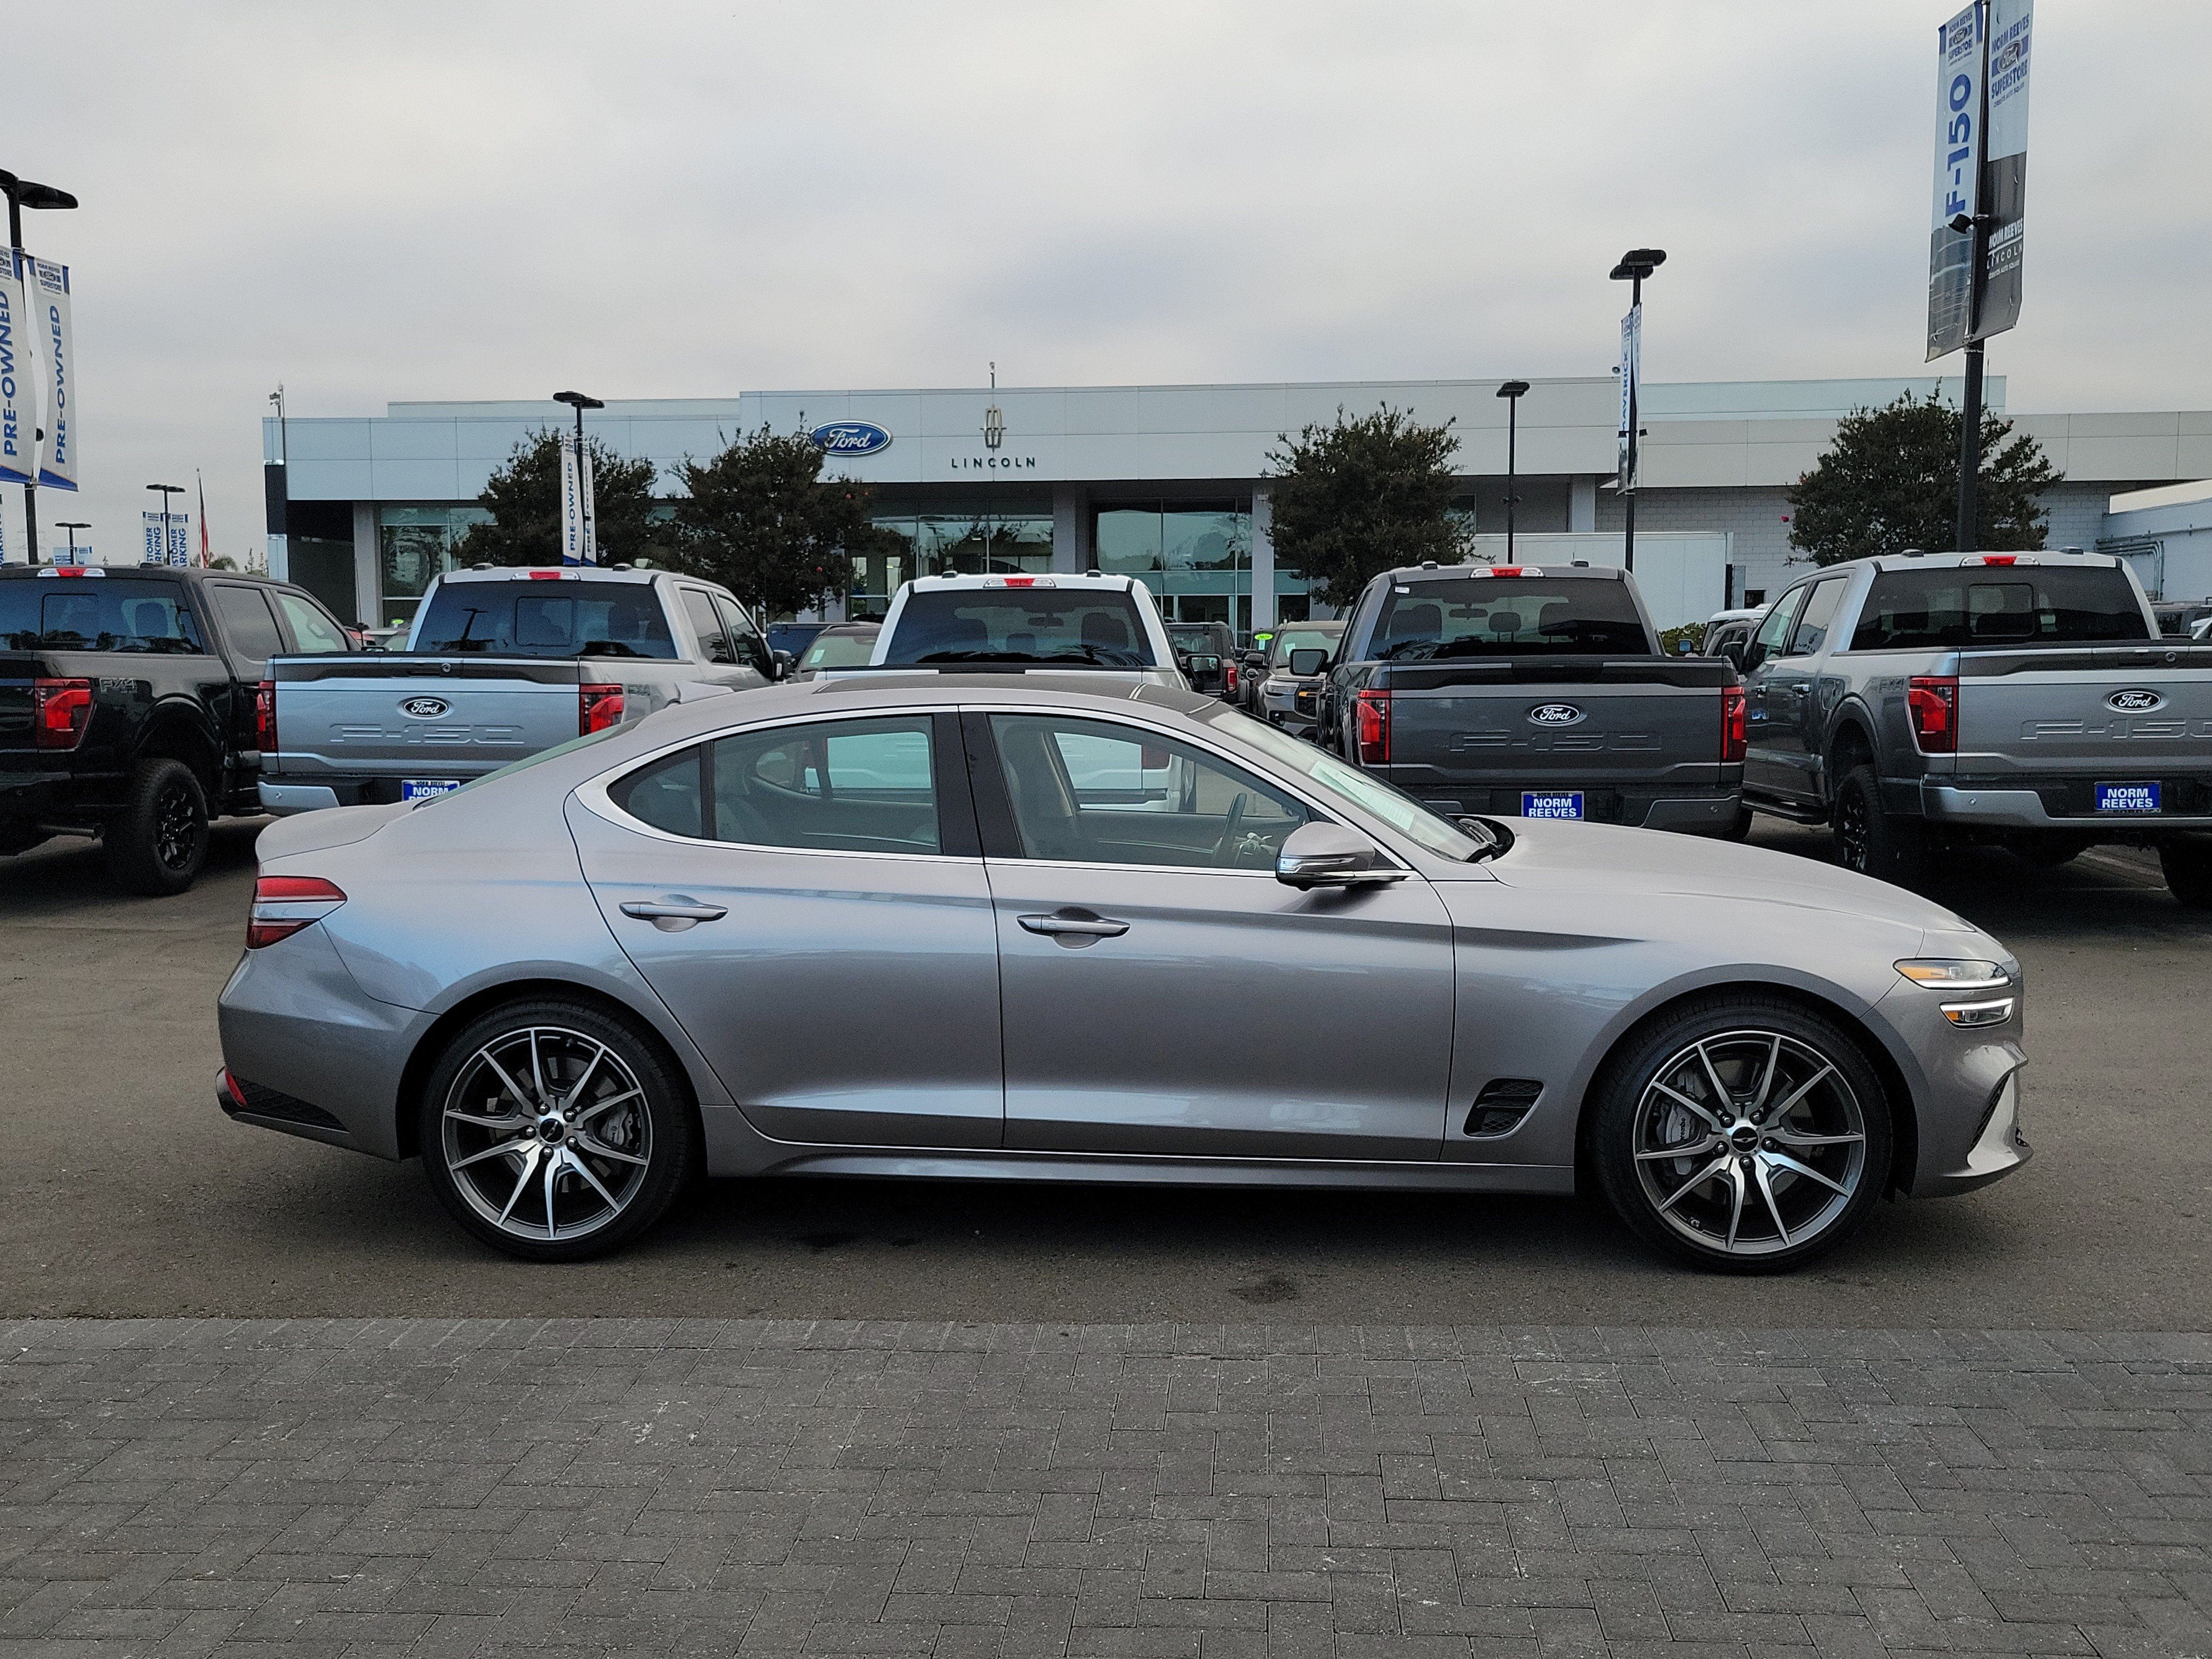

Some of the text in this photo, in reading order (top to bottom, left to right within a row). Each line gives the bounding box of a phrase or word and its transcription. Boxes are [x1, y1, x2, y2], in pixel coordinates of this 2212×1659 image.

[2010, 13, 2029, 40] REEVES
[1991, 59, 2028, 99] SUPERSTORE
[1945, 74, 1971, 217] F-150
[2004, 218, 2022, 241] REEVES
[1987, 243, 2022, 269] LINCOLN
[0, 290, 17, 456] PRE-OWNED
[49, 305, 66, 464] PRE-OWNED
[823, 428, 872, 448] Ford
[951, 457, 1035, 468] LINCOLN
[567, 462, 576, 551] PRE-OWNED
[154, 527, 162, 562] RKING
[411, 697, 441, 714] Ford
[2118, 693, 2152, 708] Ford
[1539, 708, 1571, 720] Ford
[330, 724, 524, 744] F-150
[1449, 731, 1661, 752] F-150
[413, 787, 449, 796] NORM
[2107, 788, 2148, 798] NORM
[1528, 808, 1577, 817] REEVES
[1533, 798, 1572, 808] NORM
[2102, 798, 2153, 808] REEVES
